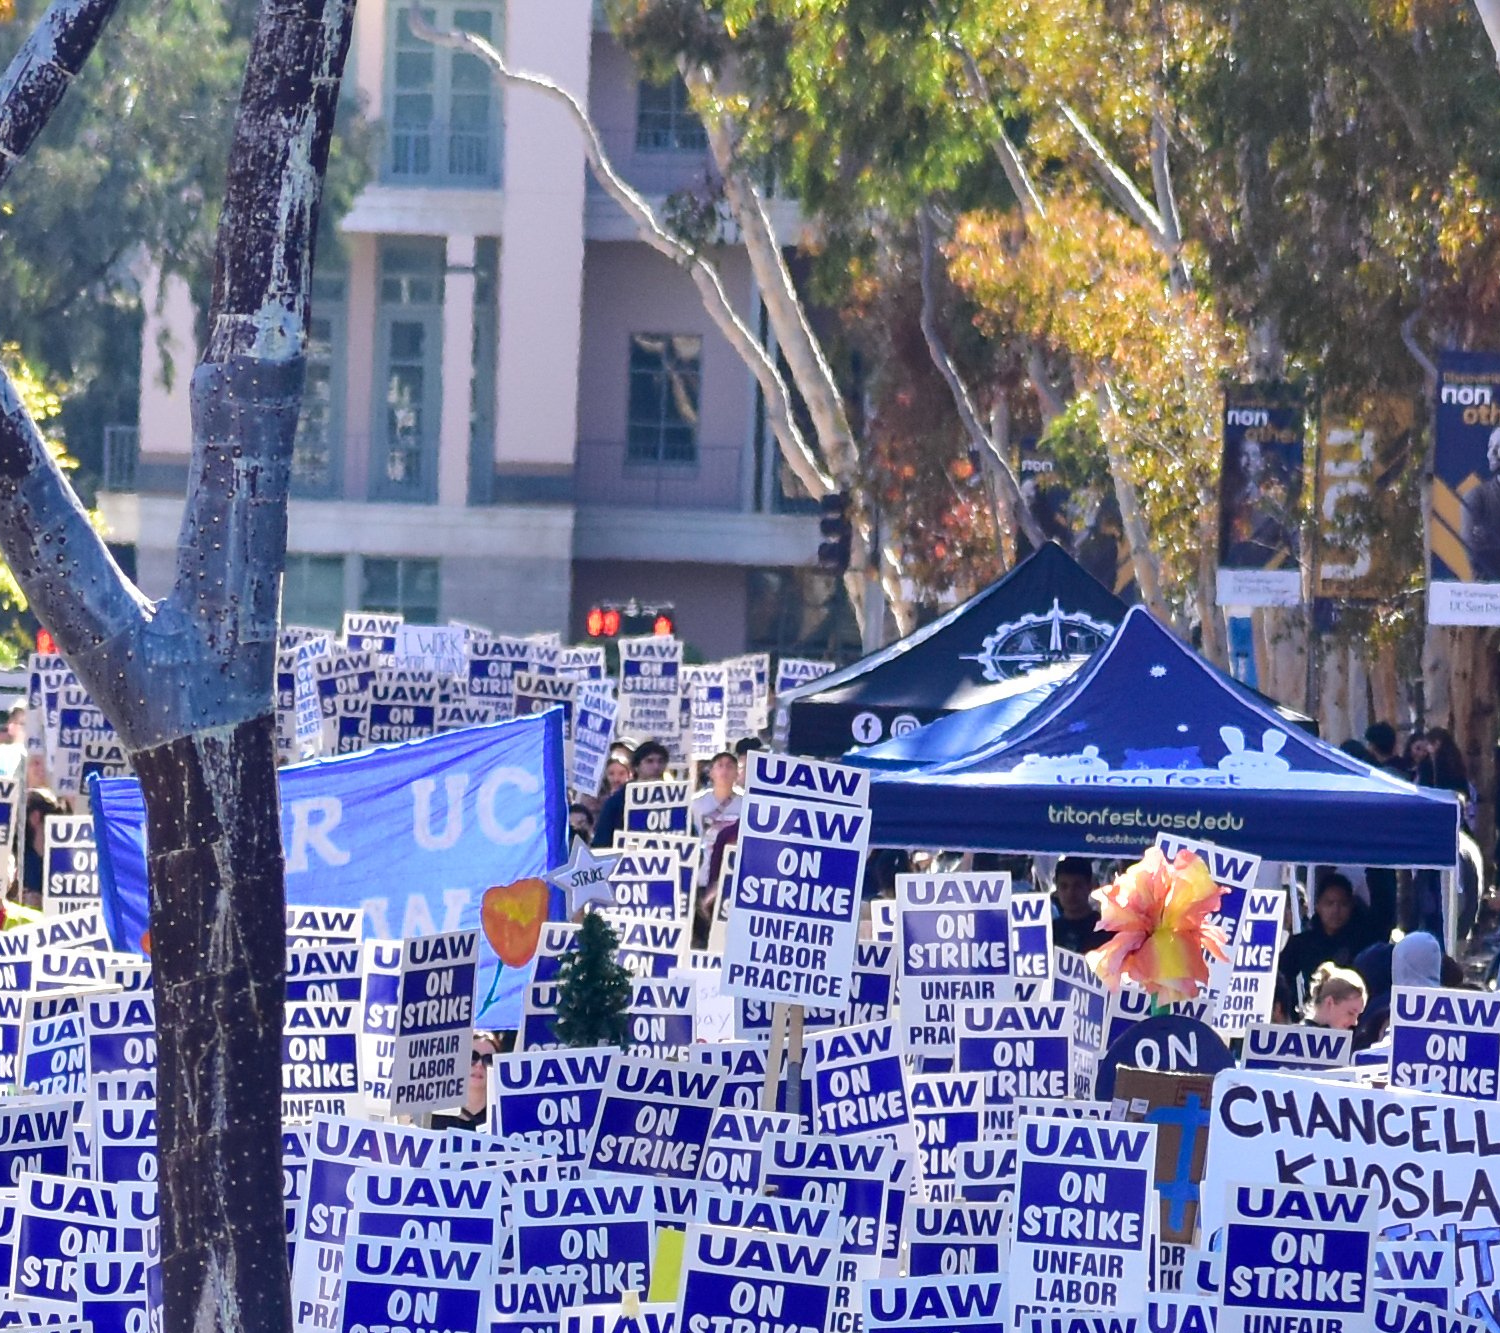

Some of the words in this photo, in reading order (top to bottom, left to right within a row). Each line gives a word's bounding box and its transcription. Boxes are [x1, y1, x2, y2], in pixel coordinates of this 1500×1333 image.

[1441, 385, 1491, 405] non
[623, 642, 679, 657] UAW
[639, 660, 663, 676] ON
[621, 674, 679, 693] STRIKE
[1055, 772, 1153, 786] triton
[1164, 771, 1241, 787] fest
[409, 767, 542, 852] UC
[746, 802, 864, 843] UAW
[1048, 805, 1244, 831] tritonfest.ucsd.edu
[571, 867, 605, 887] STRIKE
[775, 846, 822, 879] ON
[739, 874, 851, 915] STRIKE
[748, 914, 834, 946] UNFAIR
[749, 940, 826, 970] LABOR
[727, 963, 842, 998] PRACTICE
[1135, 1031, 1198, 1072] ON
